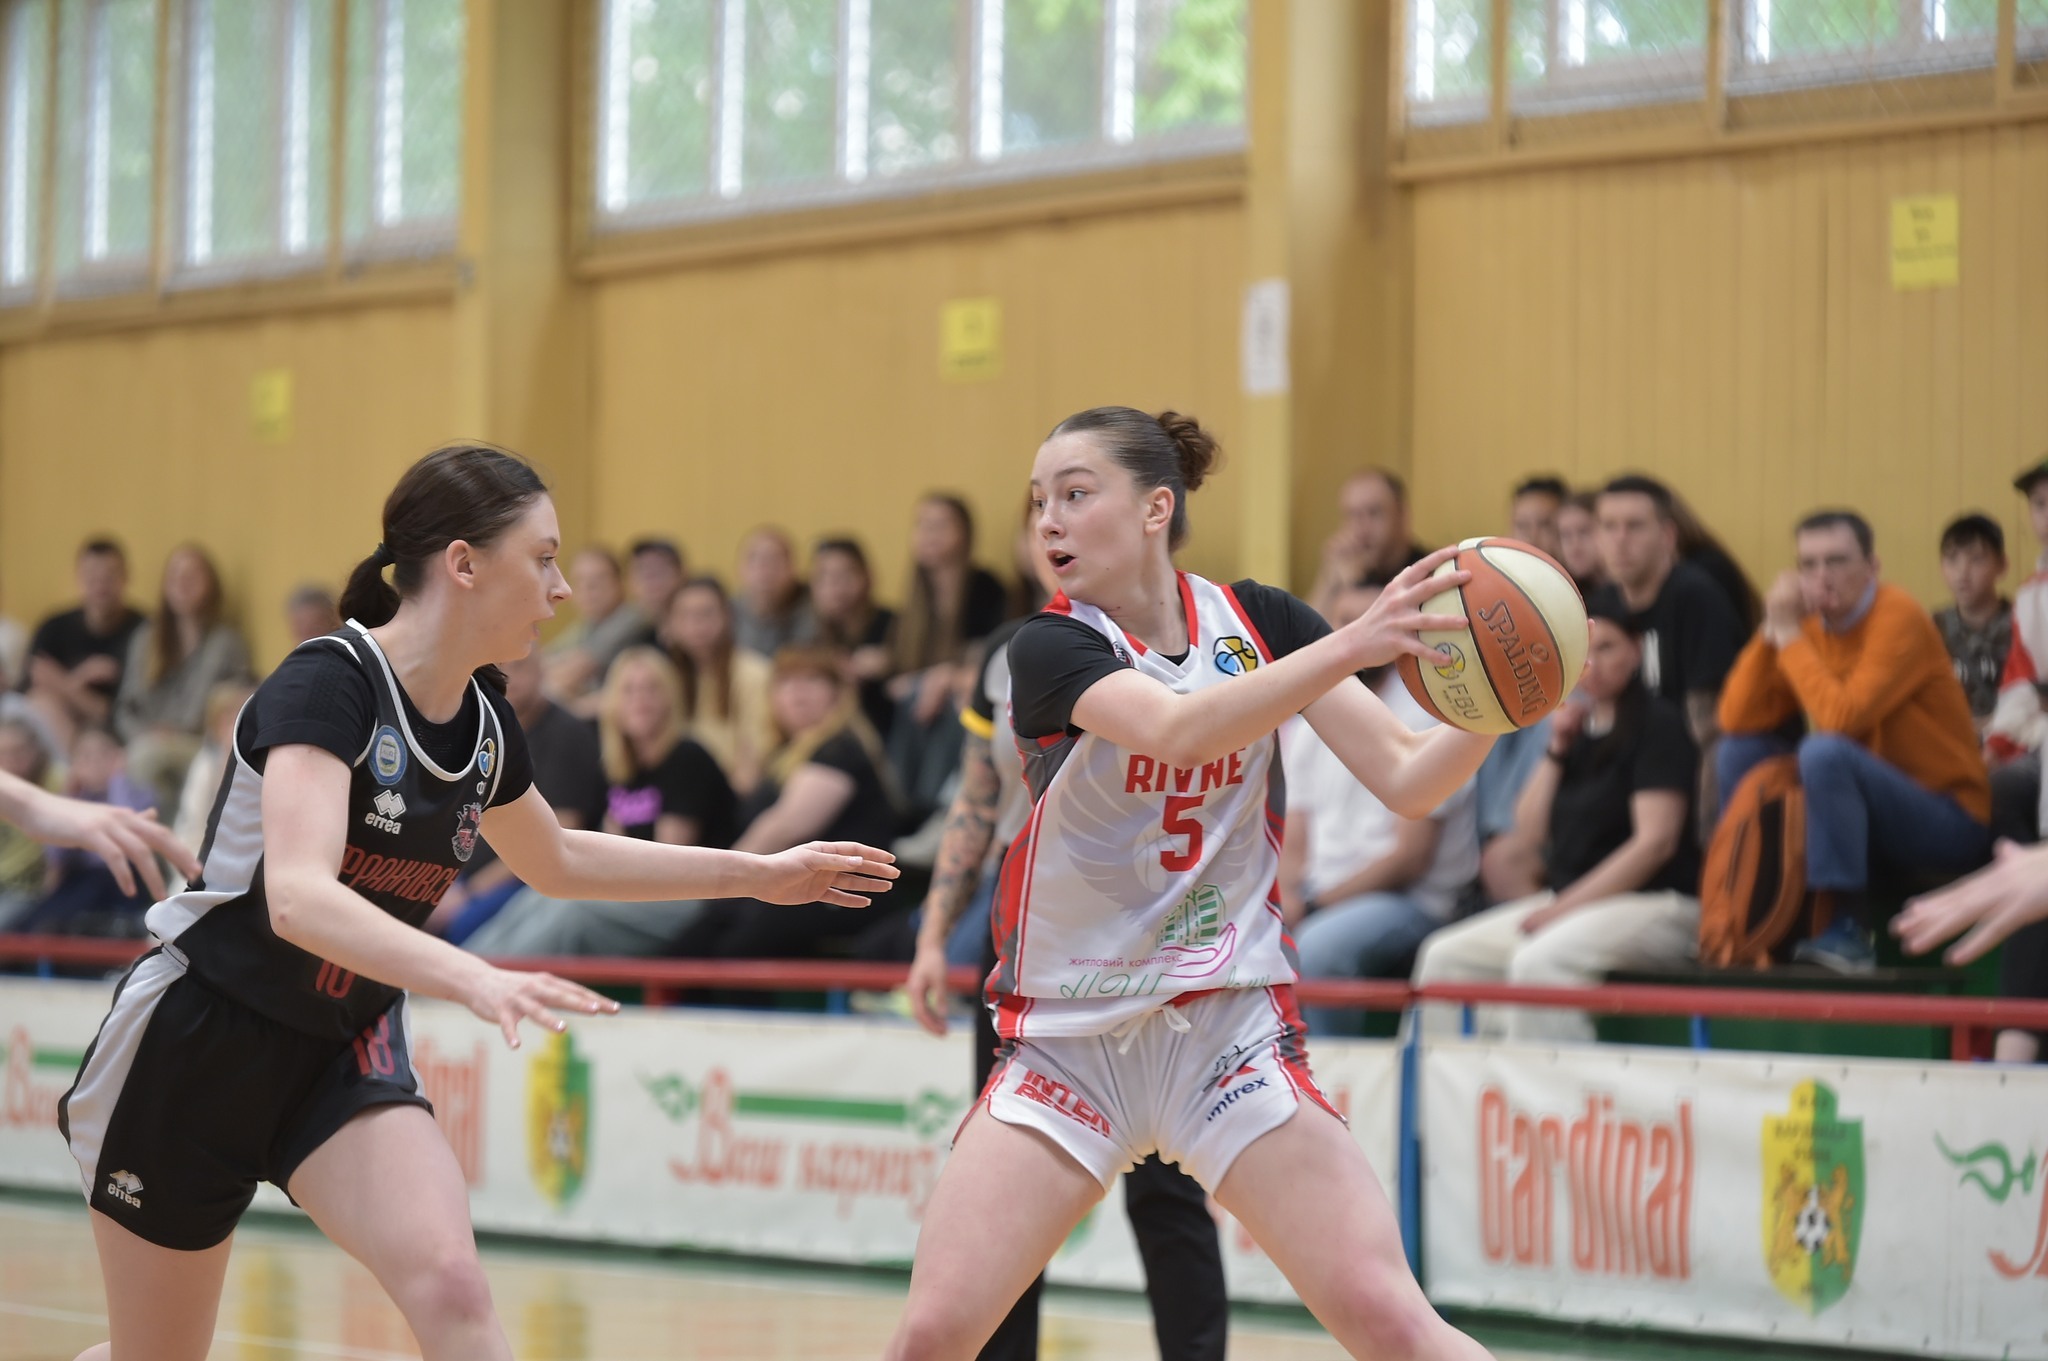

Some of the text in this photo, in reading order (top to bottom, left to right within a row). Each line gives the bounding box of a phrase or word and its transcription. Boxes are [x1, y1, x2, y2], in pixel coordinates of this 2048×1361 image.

[1477, 600, 1548, 716] SPALDING
[1448, 684, 1483, 719] FBU
[1125, 748, 1245, 793] RIVNE
[364, 812, 402, 835] errea
[1160, 794, 1205, 872] 5
[1069, 954, 1183, 968] житловий комплекс
[108, 1183, 141, 1208] errea
[1480, 1086, 1693, 1280] Cardinal
